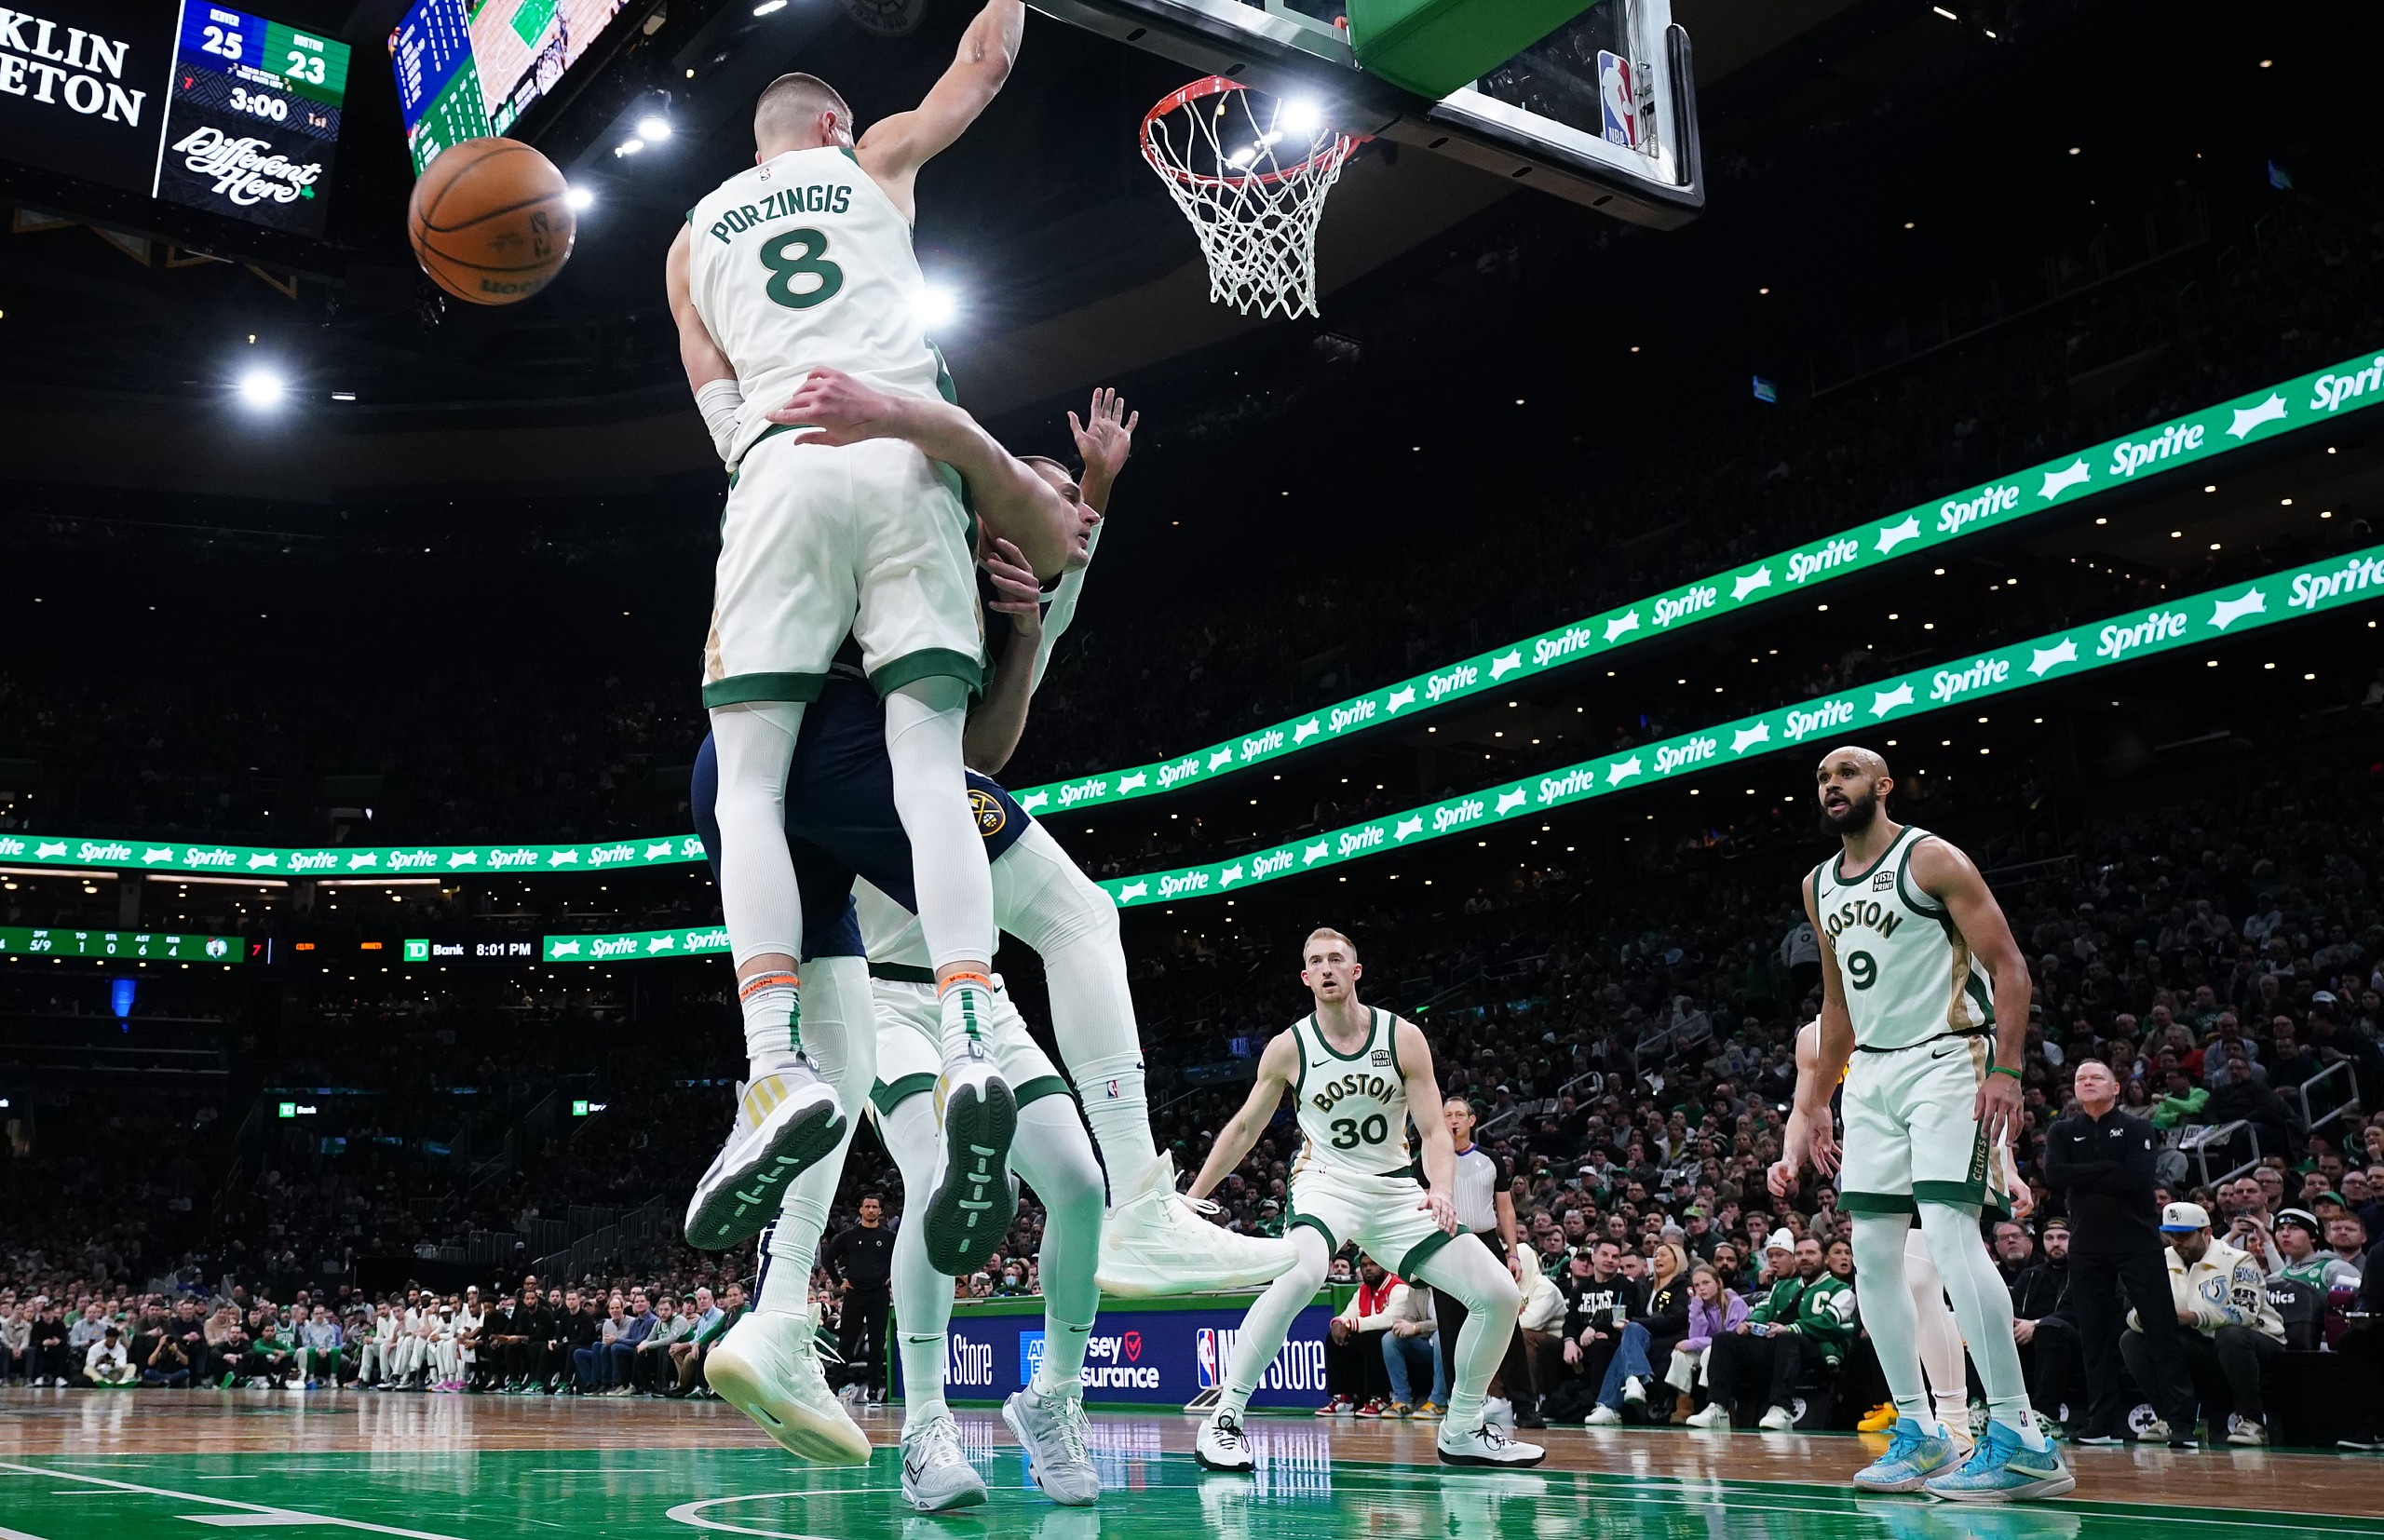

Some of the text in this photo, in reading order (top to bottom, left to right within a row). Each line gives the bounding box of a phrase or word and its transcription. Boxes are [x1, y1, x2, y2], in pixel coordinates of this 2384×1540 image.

[201, 25, 243, 60] 25
[285, 51, 326, 85] 23
[230, 88, 288, 121] 3:00
[171, 126, 322, 184] Different
[211, 166, 301, 206] Here
[710, 184, 852, 245] PORZINGIS
[758, 226, 846, 311] 8
[1058, 357, 2384, 806] Sprite Sprite Sprite Sprite Sprite Sprite Sprite Sprite Sprite Sprite Spri
[1158, 871, 1209, 898] Sprite
[1252, 850, 1294, 879] Sprite
[1338, 826, 1384, 857] Sprite
[1433, 800, 1483, 832] Sprite
[1537, 770, 1593, 804] Sprite
[1654, 736, 1716, 774] Sprite
[1784, 700, 1853, 740] Sprite
[1930, 658, 2009, 702] Sprite
[2097, 612, 2187, 658] Sprite
[77, 843, 131, 862] Sprite
[183, 848, 237, 868] Sprite
[288, 852, 337, 871] Sprite
[386, 850, 437, 871] Sprite
[487, 849, 537, 869] Sprite
[588, 844, 634, 867] Sprite
[1874, 881, 1893, 891] PRINT
[1875, 871, 1894, 884] VISTA
[1825, 899, 1903, 952] BOSTON
[29, 939, 177, 957] 5/9 1 0 6 4
[252, 944, 262, 956] 7
[406, 942, 464, 958] TD Bank
[476, 943, 531, 956] 8:01 PM
[589, 938, 637, 958] Sprite
[1848, 951, 1877, 991] 9
[1372, 1050, 1389, 1060] VISTA
[1312, 1074, 1396, 1114] BOSTON
[1330, 1114, 1388, 1149] 30
[1972, 1139, 1986, 1182] CELTICS
[2267, 1290, 2296, 1304] ltics
[954, 1333, 993, 1385] Store
[1089, 1336, 1122, 1365] sey
[1080, 1367, 1159, 1388] surance
